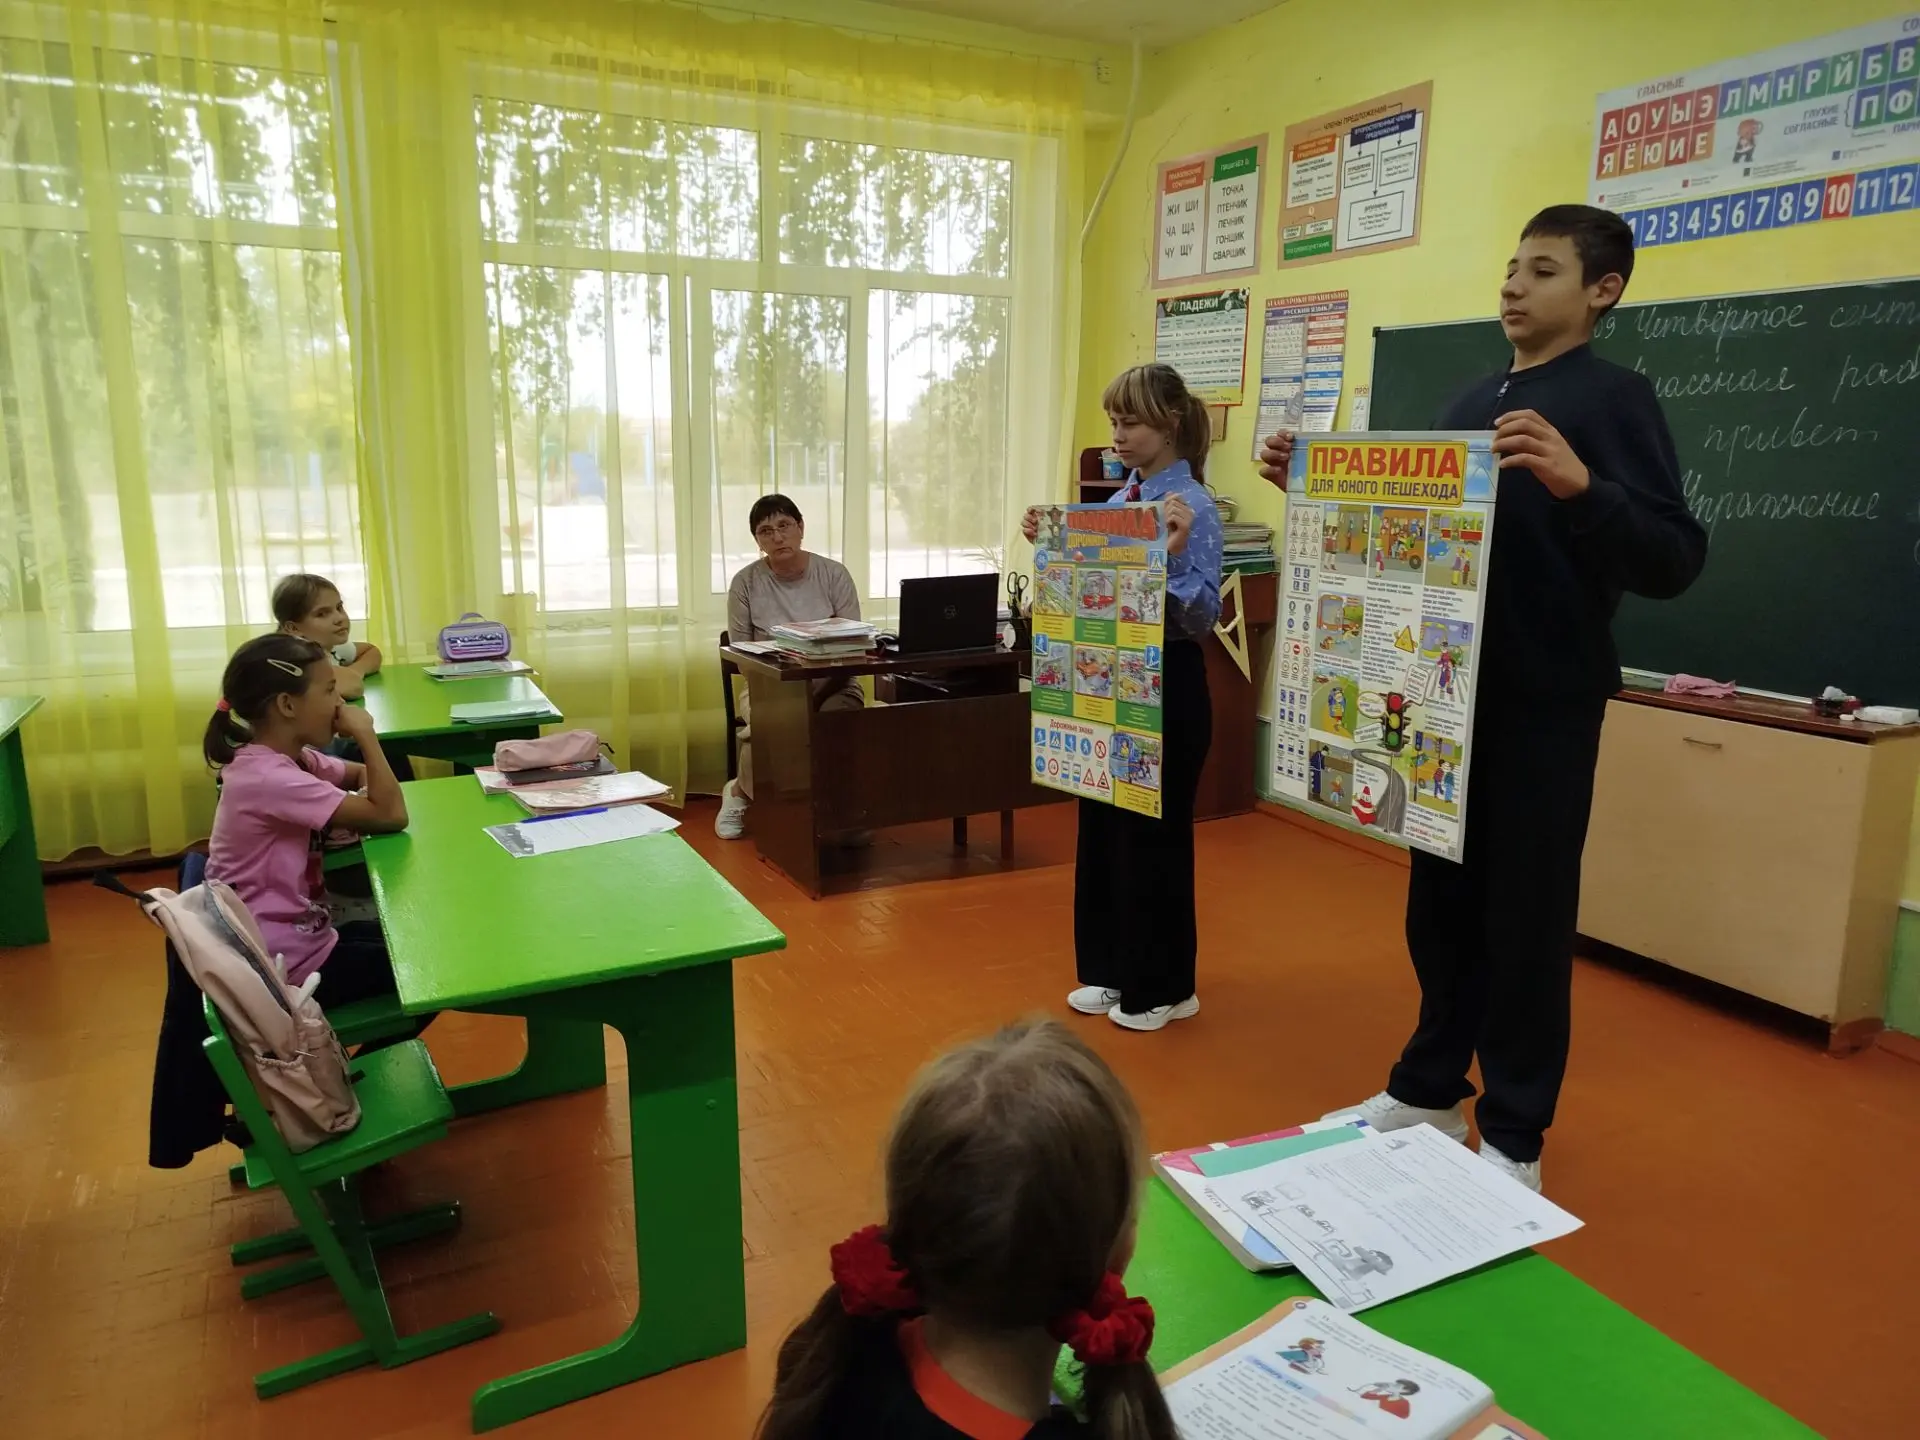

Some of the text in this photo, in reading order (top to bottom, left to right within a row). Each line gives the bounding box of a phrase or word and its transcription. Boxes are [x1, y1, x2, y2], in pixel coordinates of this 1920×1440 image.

[1604, 118, 1618, 141] А
[1651, 105, 1666, 130] У
[1671, 99, 1692, 125] Ы
[1698, 94, 1714, 118] Э
[1722, 87, 1742, 113] Л
[1748, 81, 1769, 108] М
[1777, 74, 1795, 101] Н
[1805, 68, 1822, 94] Р
[1833, 55, 1854, 88] Й
[1865, 54, 1883, 80] Б
[1896, 46, 1915, 73] В
[1636, 77, 1685, 100] ГЛАСНЫЕ
[1803, 103, 1840, 120] ГЛУХИЕ
[1860, 89, 1914, 122] П Ф
[1783, 116, 1840, 135] СОГЛАСНЫЕ
[1601, 132, 1708, 175] Я Ё Ю И Е
[1222, 184, 1244, 197] ТОЧКА
[1167, 199, 1199, 216] ЖИ ШИ
[1217, 198, 1248, 214] ПТЕНЧИК
[1644, 214, 1657, 242] 2
[1665, 211, 1679, 239] 3
[1686, 207, 1700, 235] 4
[1708, 203, 1723, 233] 5
[1731, 200, 1745, 229] 6
[1755, 196, 1771, 226] 7
[1778, 191, 1794, 222] 8
[1803, 187, 1820, 219] 9
[1826, 181, 1852, 216] 10
[1858, 177, 1882, 210] 11
[1888, 172, 1914, 205] 12
[1166, 222, 1195, 237] ЧА ЩА
[1217, 215, 1245, 228] ПЕЧНИК
[1215, 231, 1245, 245] ГОНЩИК
[1165, 244, 1194, 258] ЧУ ЩУ
[1213, 247, 1246, 261] СВАРЩИК
[1179, 297, 1219, 312] ПАДЕЖИ
[1283, 304, 1328, 315] РУССКИЙ ЯЗЫК
[1634, 299, 1809, 364] Четвёртое
[1704, 405, 1879, 478] привет
[1311, 446, 1461, 479] ПРАВИЛА
[1310, 478, 1459, 501] ДЛЯ ЮНОГО ПЕШЕХОДА
[1681, 468, 1880, 547] Упражнение
[1050, 718, 1078, 732] Дорожные
